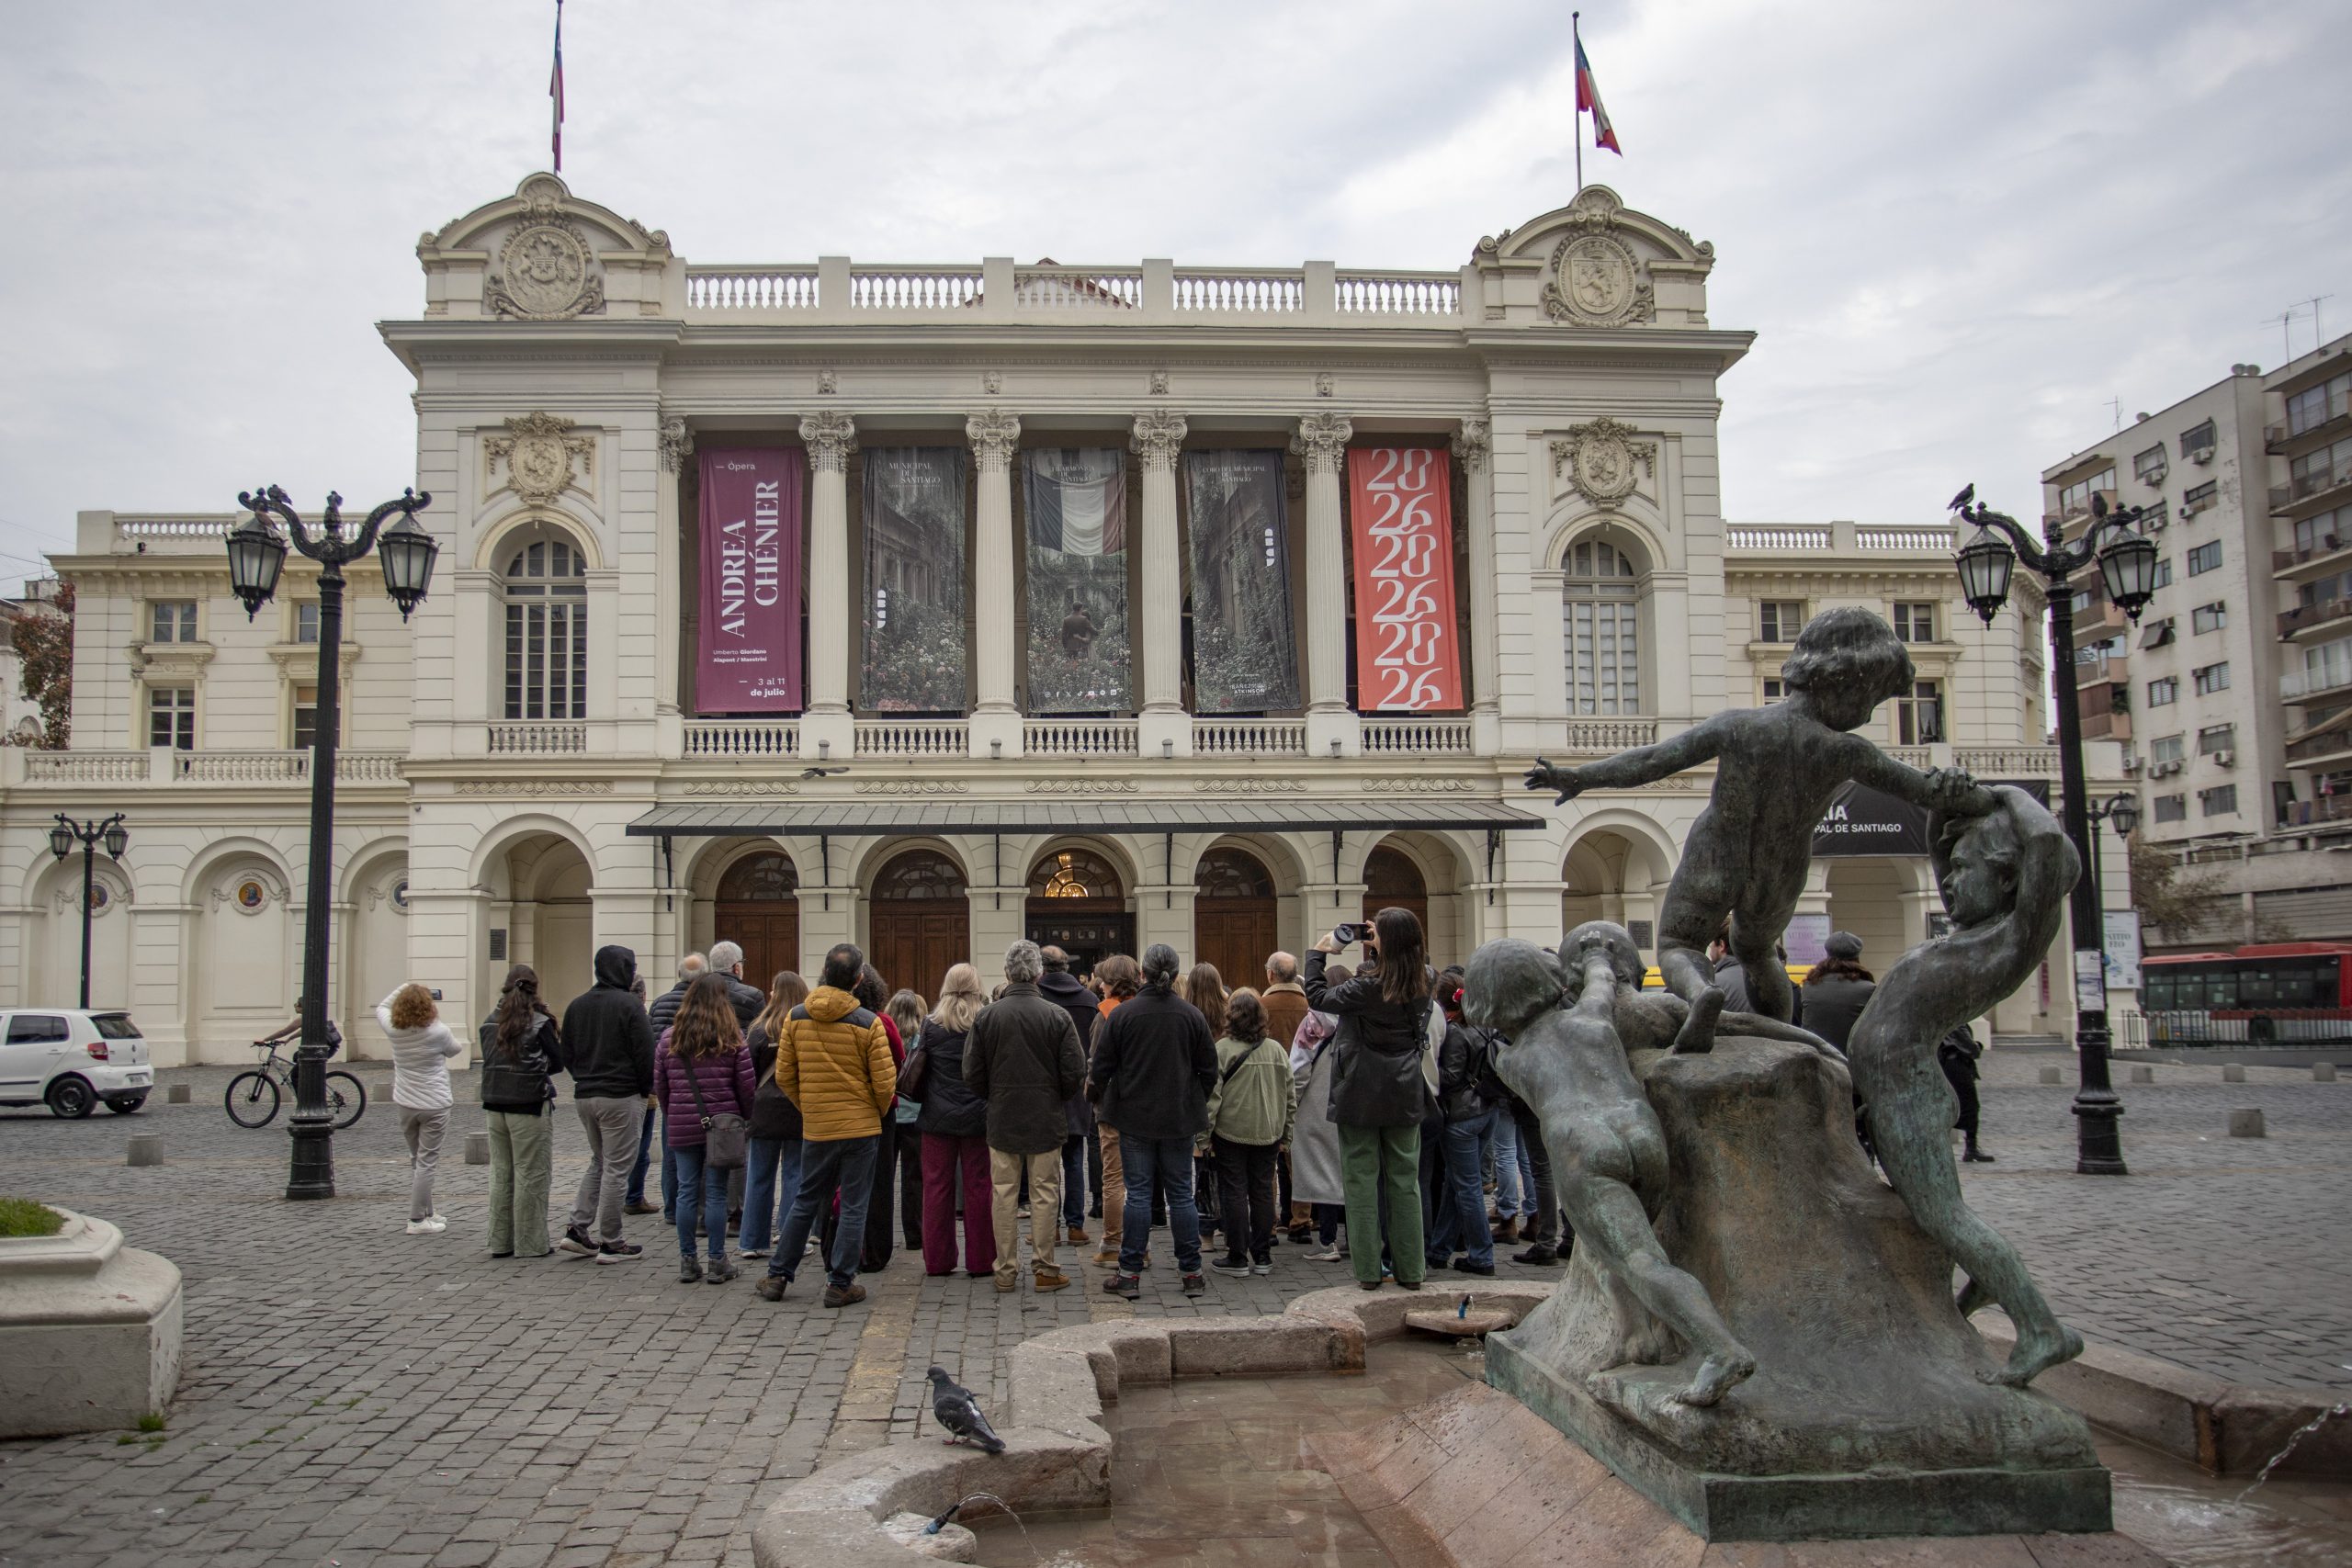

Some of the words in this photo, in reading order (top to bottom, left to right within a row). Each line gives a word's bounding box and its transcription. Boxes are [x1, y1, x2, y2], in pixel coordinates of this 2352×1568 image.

[889, 462, 932, 470] MUNICIPAL
[900, 476, 941, 484] SANTIAGO
[1366, 448, 1432, 491] 20
[1368, 492, 1434, 536] 26
[748, 480, 779, 607] CHÉNIER
[1370, 535, 1437, 578] 20
[721, 519, 747, 638] ANDREA
[1373, 580, 1439, 623] 26
[1374, 622, 1442, 666] 20
[763, 688, 786, 698] julio
[1377, 667, 1443, 711] 26
[1823, 805, 1848, 820] IA
[1835, 824, 1849, 832] DE
[1851, 823, 1902, 832] SANTIAGO
